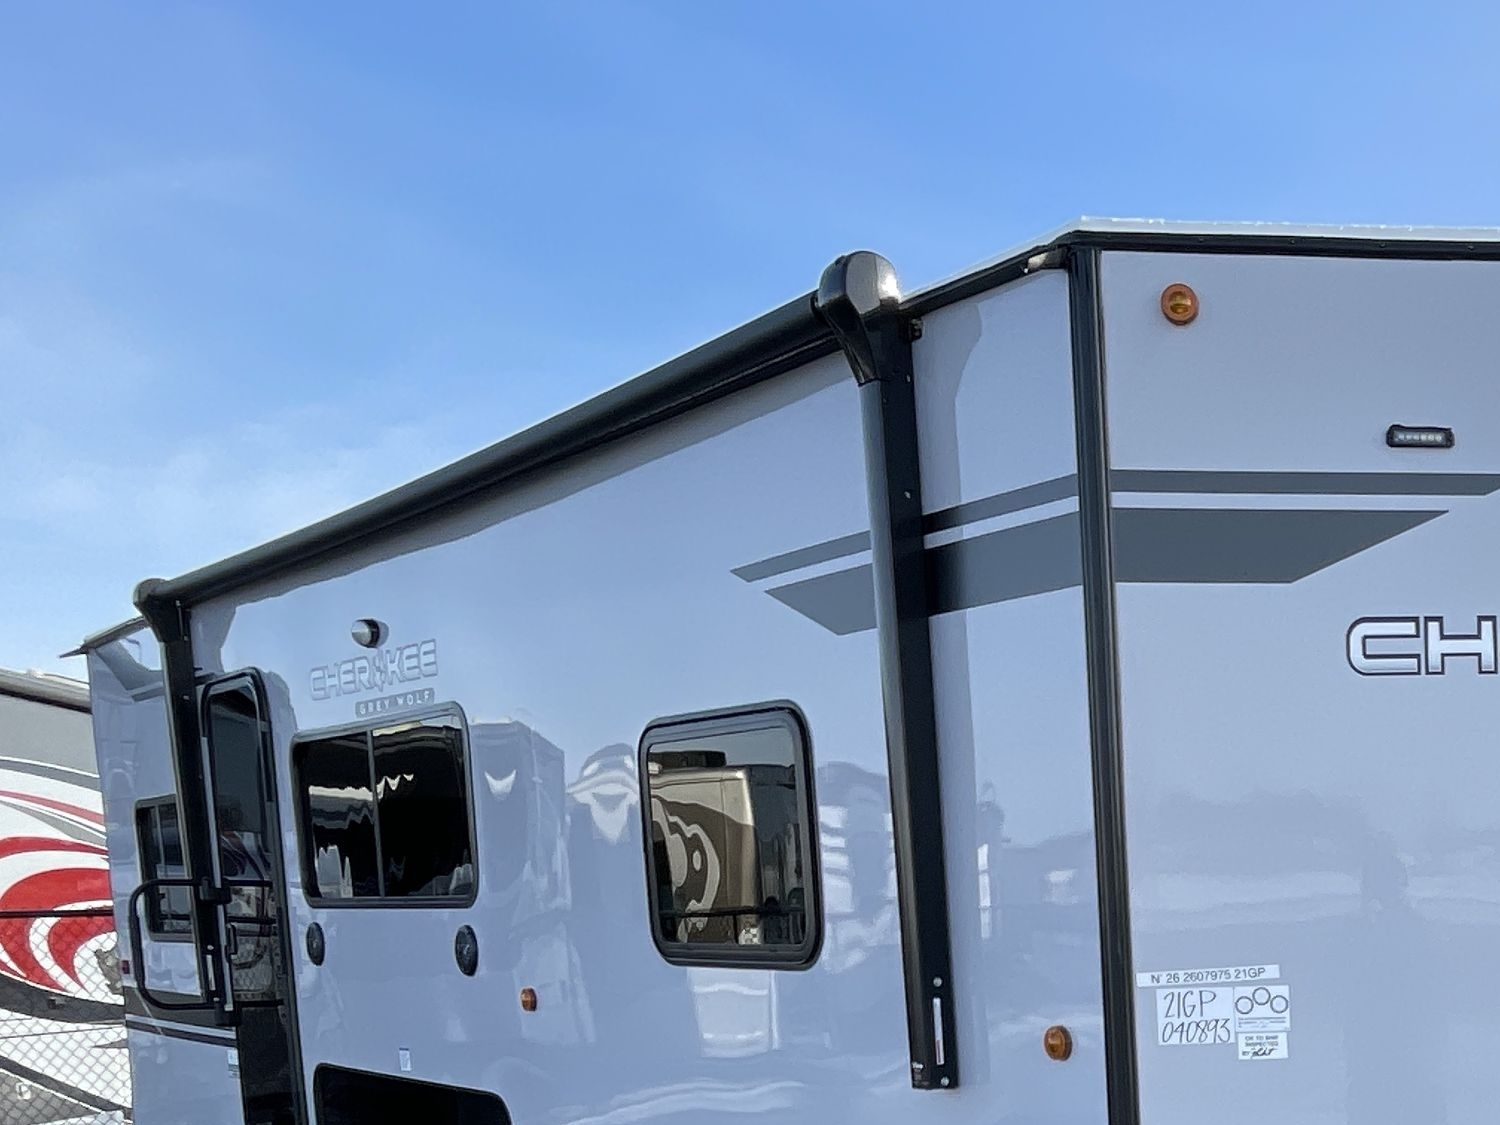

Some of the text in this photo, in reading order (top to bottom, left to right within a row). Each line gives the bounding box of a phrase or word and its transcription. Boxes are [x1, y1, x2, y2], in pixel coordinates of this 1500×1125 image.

[359, 691, 430, 715] GREY WOLF
[1166, 972, 1180, 984] 26
[1234, 967, 1266, 980] 21GP
[1163, 989, 1217, 1019] 21GP
[1161, 1018, 1231, 1044] 040893
